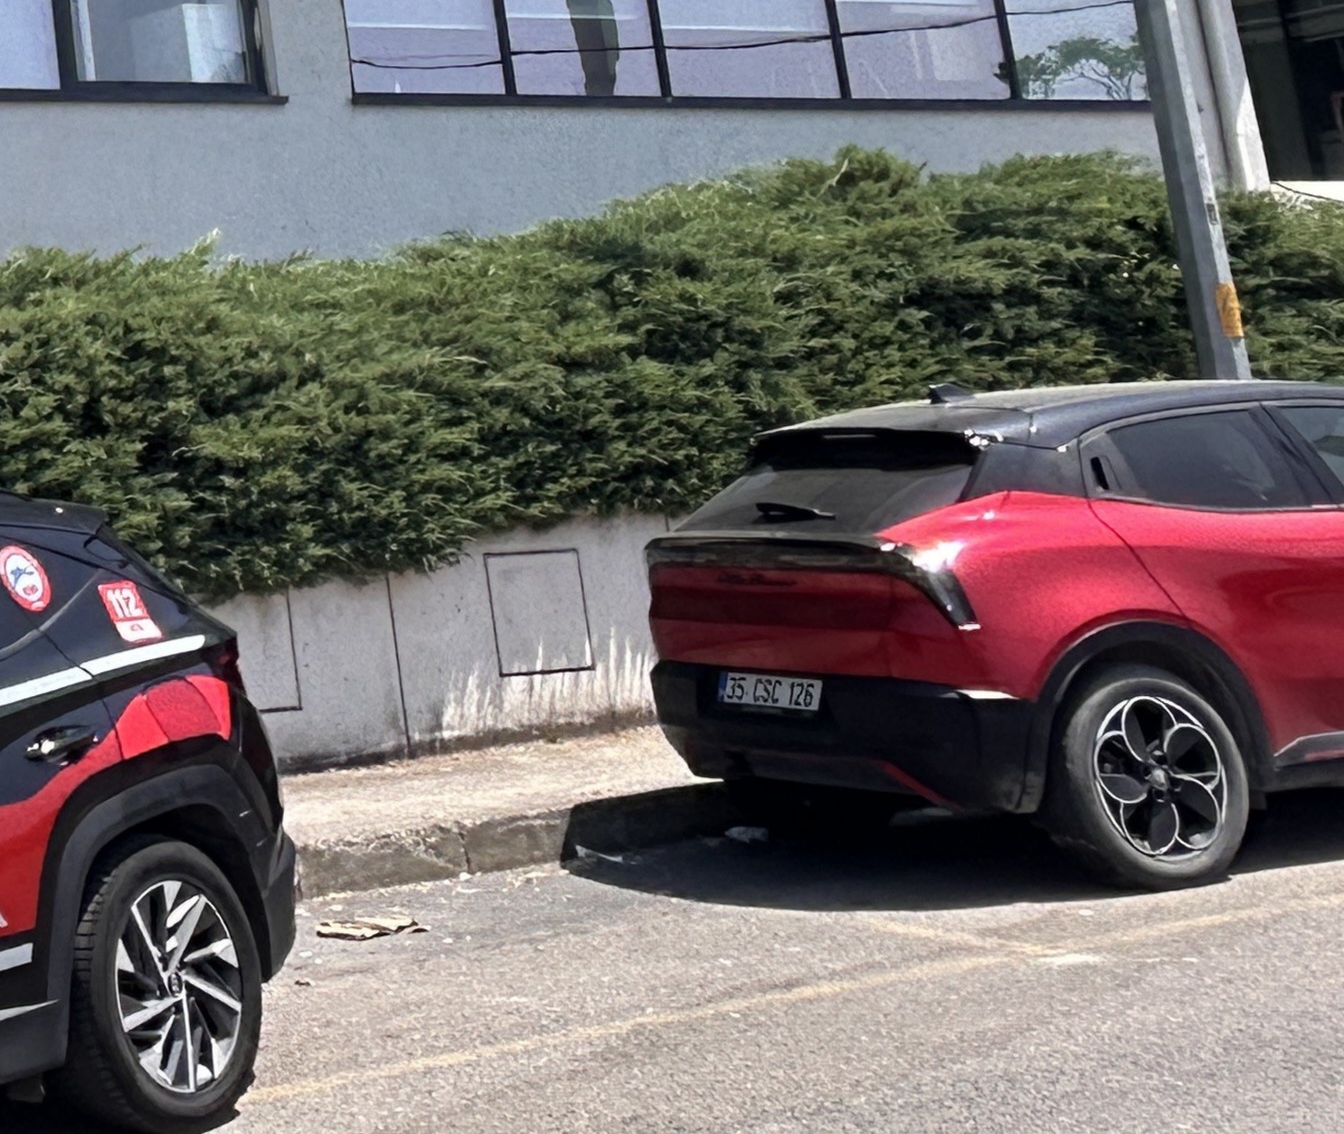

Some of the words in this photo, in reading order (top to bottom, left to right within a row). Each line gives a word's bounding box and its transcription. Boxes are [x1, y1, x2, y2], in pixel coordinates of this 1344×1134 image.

[106, 587, 144, 618] 112
[726, 677, 747, 701] 35
[789, 681, 814, 707] 126
